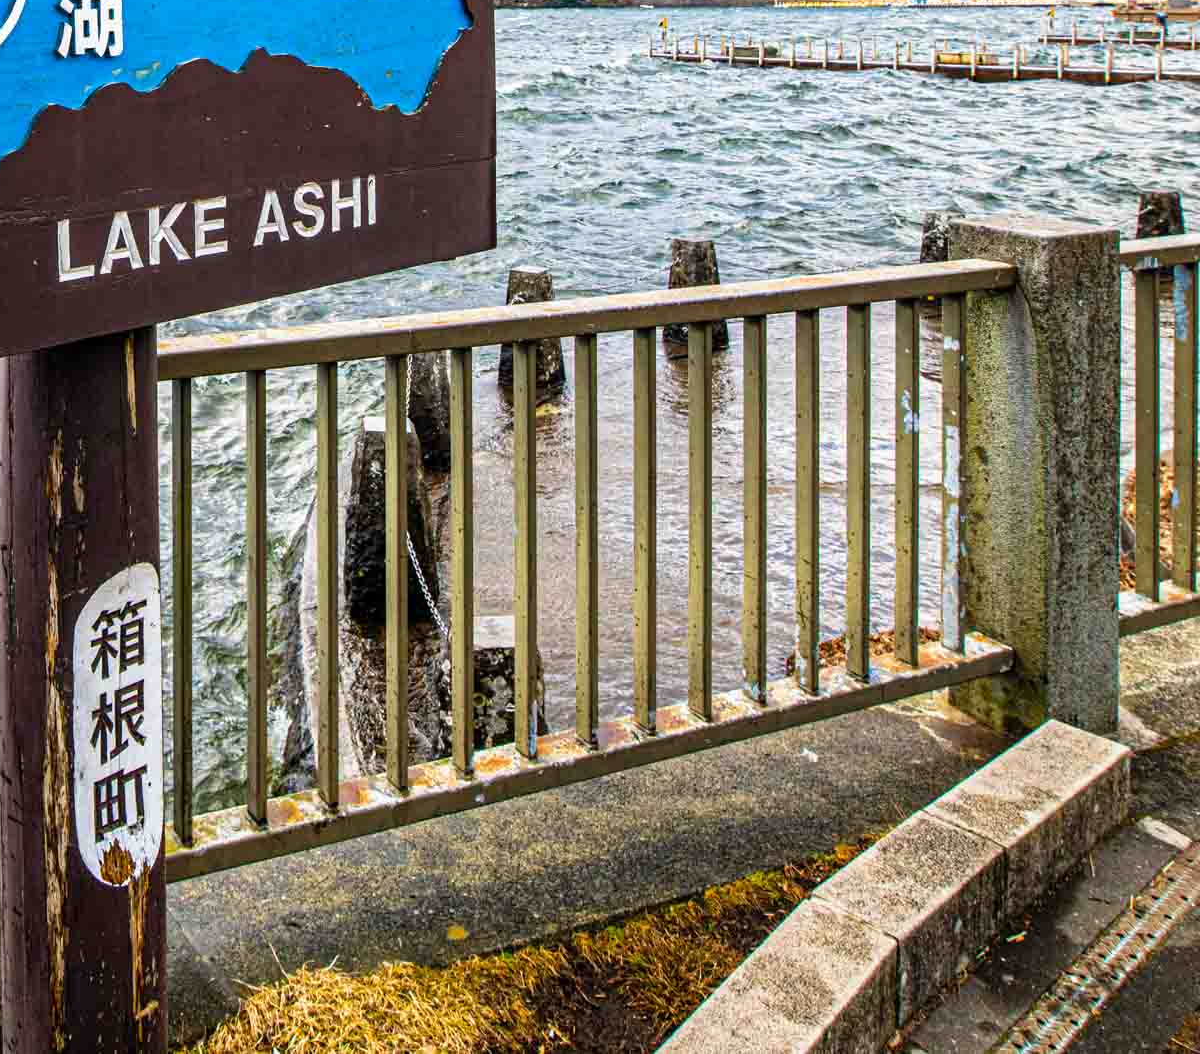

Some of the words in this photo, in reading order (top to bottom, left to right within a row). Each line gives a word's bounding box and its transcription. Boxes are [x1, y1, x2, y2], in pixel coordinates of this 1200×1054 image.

[57, 195, 229, 283] LAKE
[253, 173, 377, 247] ASHI
[90, 598, 147, 842] 箱根町
